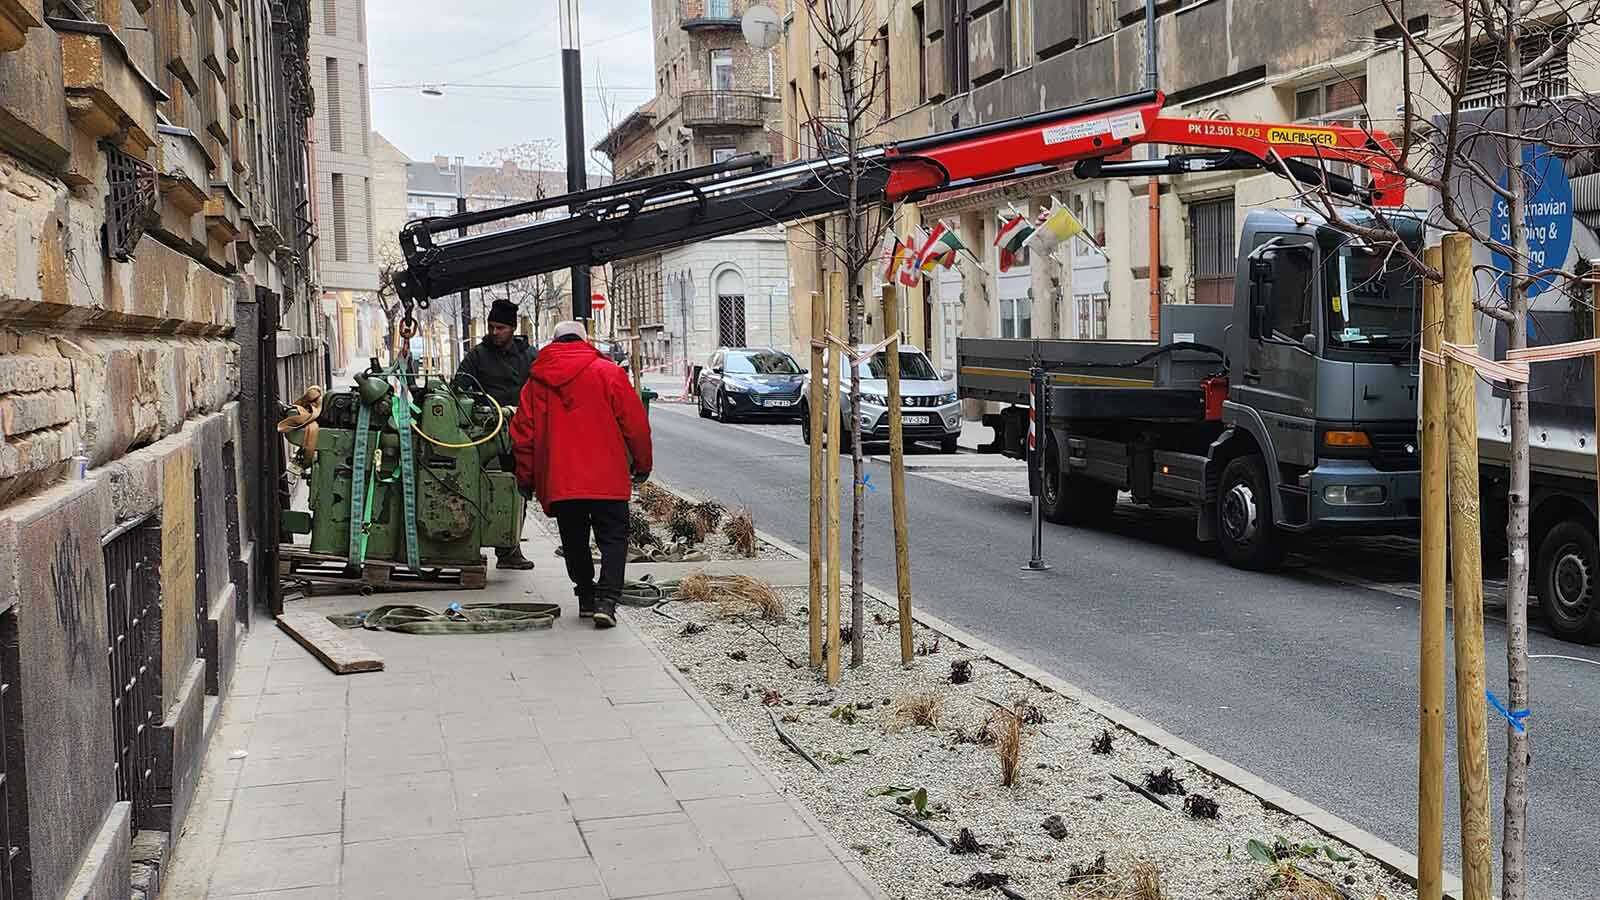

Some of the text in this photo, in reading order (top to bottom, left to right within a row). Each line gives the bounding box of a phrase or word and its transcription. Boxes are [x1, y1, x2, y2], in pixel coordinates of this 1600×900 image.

[1188, 123, 1202, 134] PK
[1204, 124, 1234, 136] 12.501
[1271, 130, 1333, 144] PALFINGER
[1548, 222, 1558, 239] &
